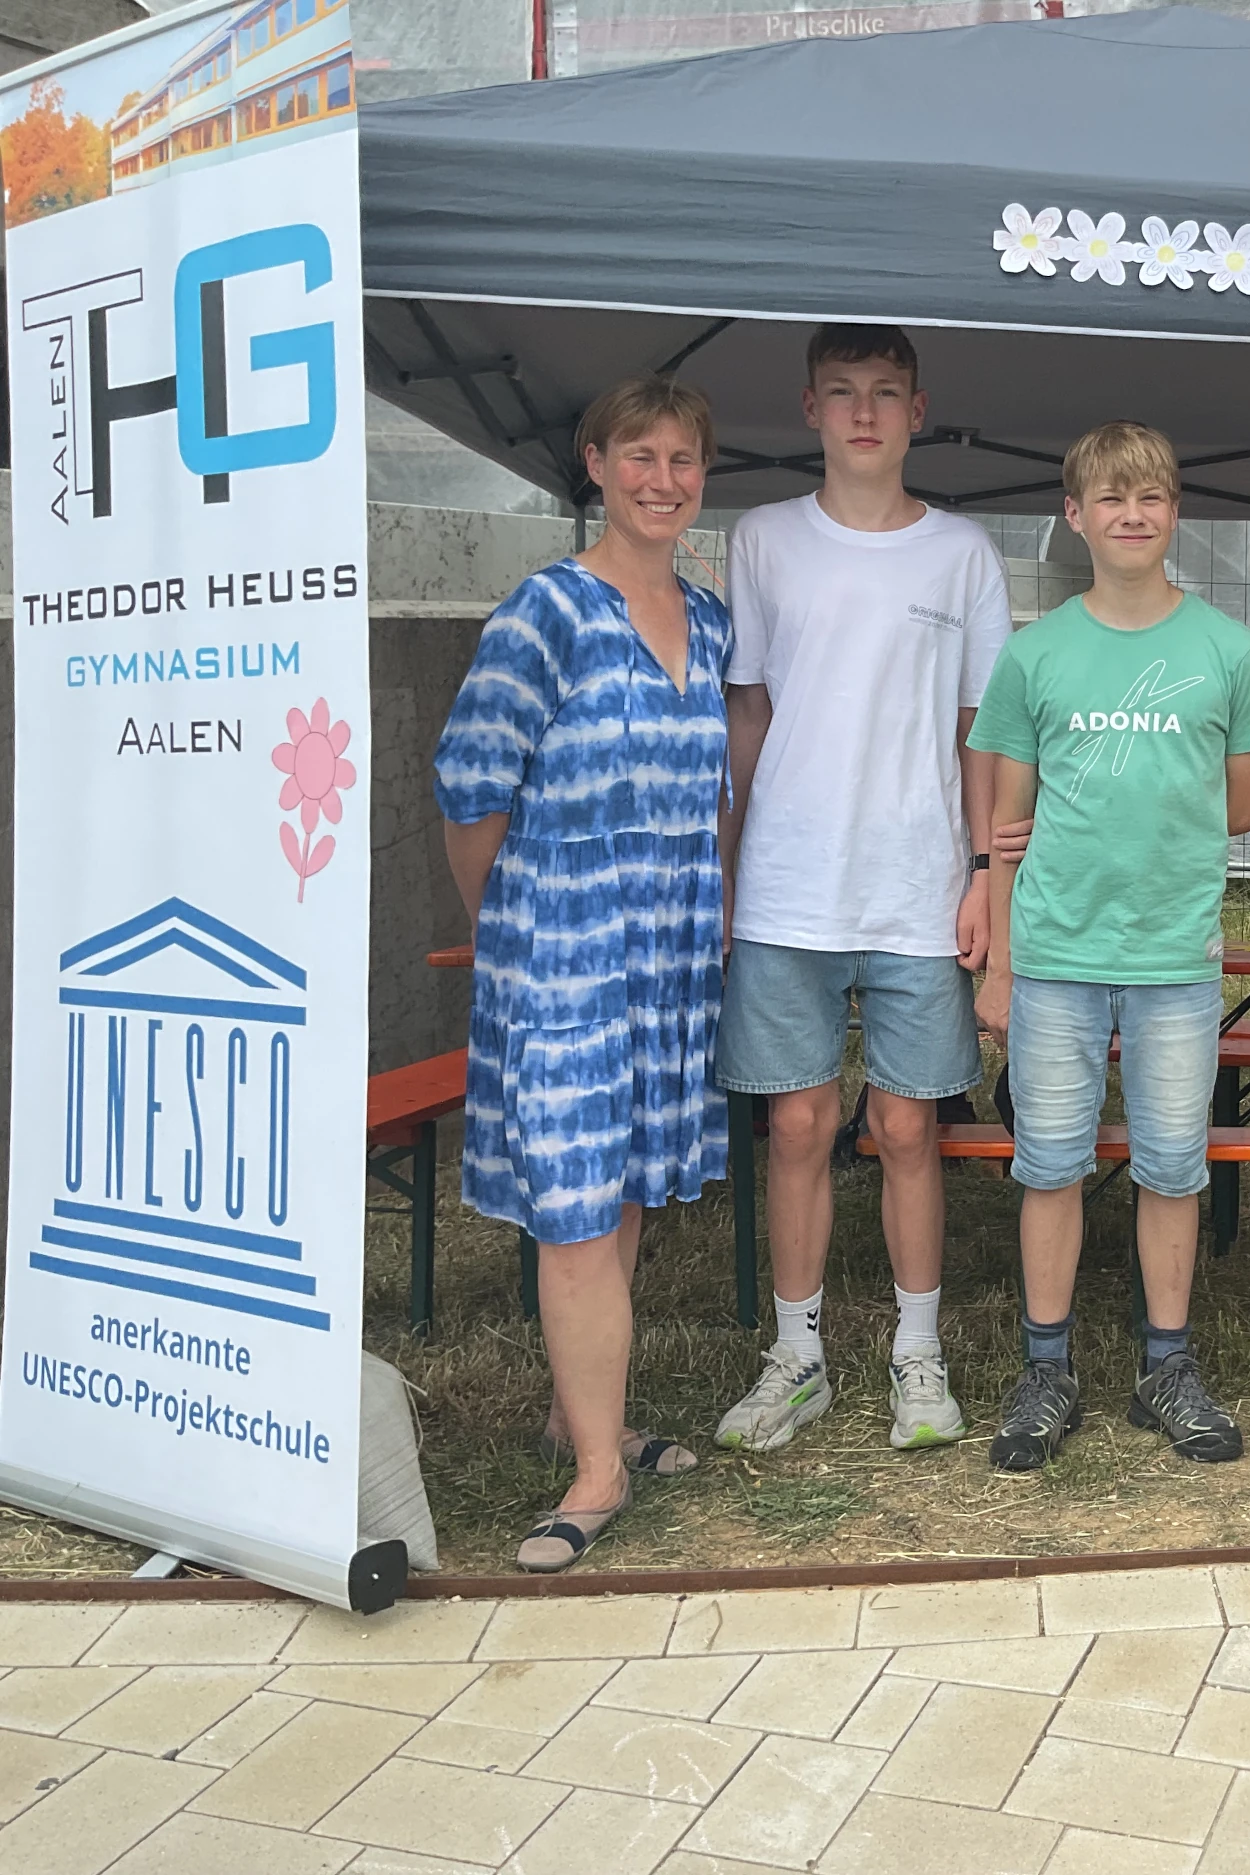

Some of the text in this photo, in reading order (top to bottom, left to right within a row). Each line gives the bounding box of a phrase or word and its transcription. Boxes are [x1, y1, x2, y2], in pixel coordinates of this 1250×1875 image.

[49, 334, 69, 526] AALEN
[22, 563, 358, 626] THEODOR HEUSS
[67, 641, 300, 688] GYMNASIUM
[1069, 711, 1182, 734] ADONIA
[65, 1012, 290, 1227] UNESCO
[91, 1311, 251, 1376] anerkannte
[22, 1351, 330, 1464] UNESCO-Projektschule
